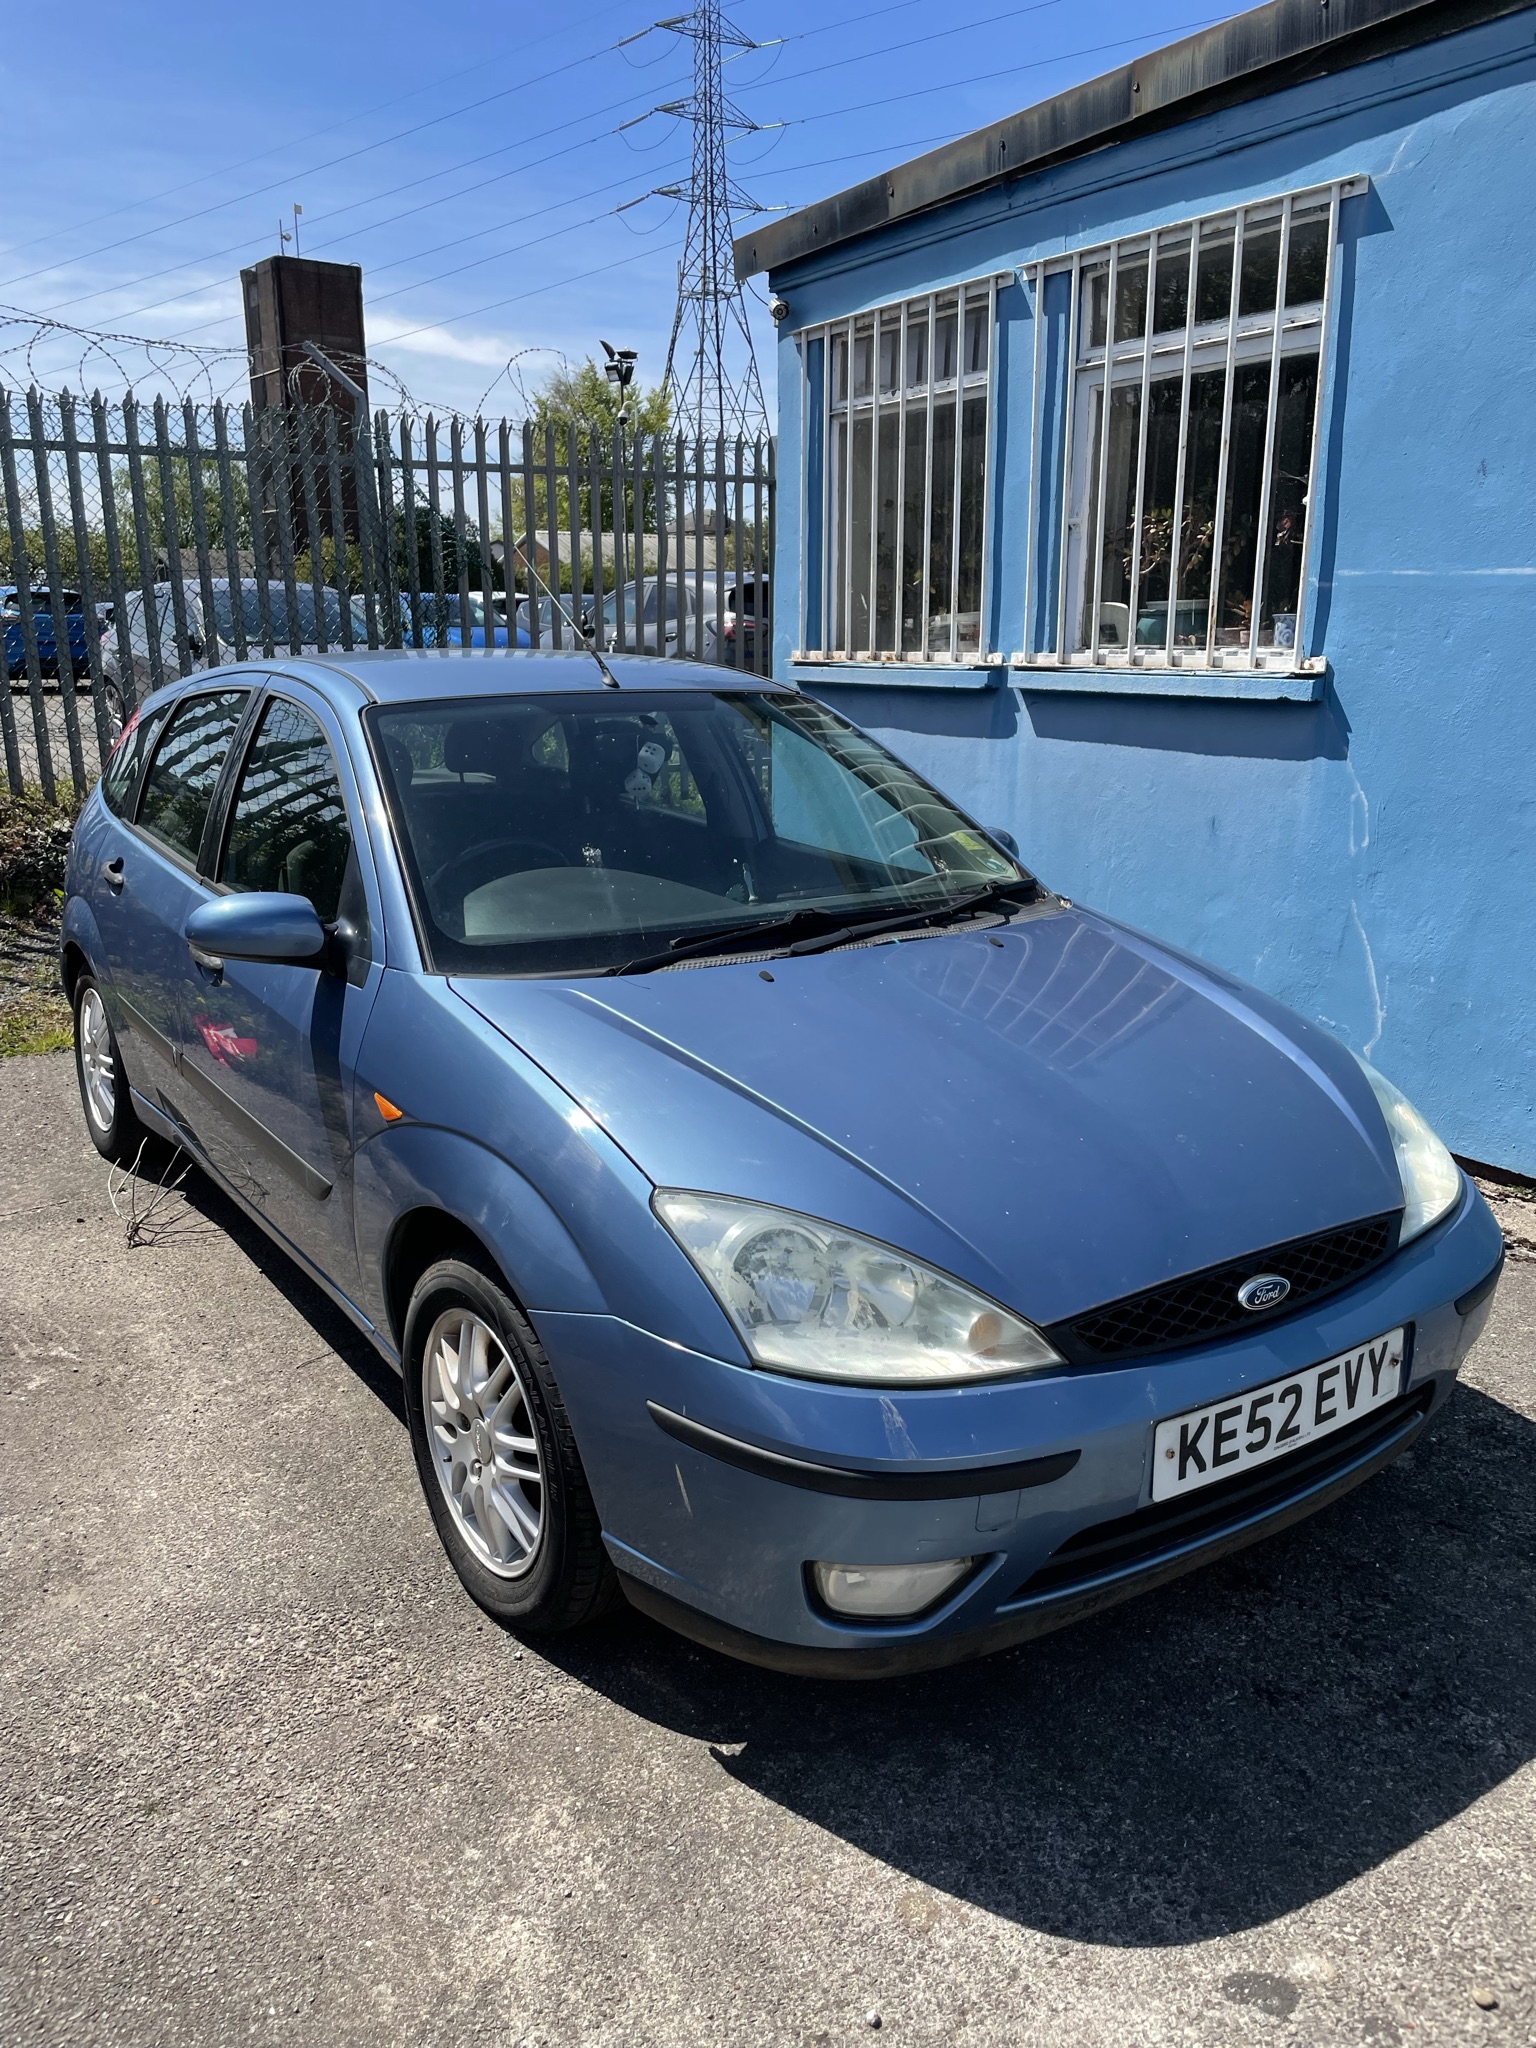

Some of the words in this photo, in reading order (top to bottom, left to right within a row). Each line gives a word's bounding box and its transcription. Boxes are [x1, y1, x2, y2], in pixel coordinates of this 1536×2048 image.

[1254, 1284, 1280, 1304] Ford
[1177, 1383, 1303, 1481] KE52
[1314, 1340, 1389, 1427] EVY
